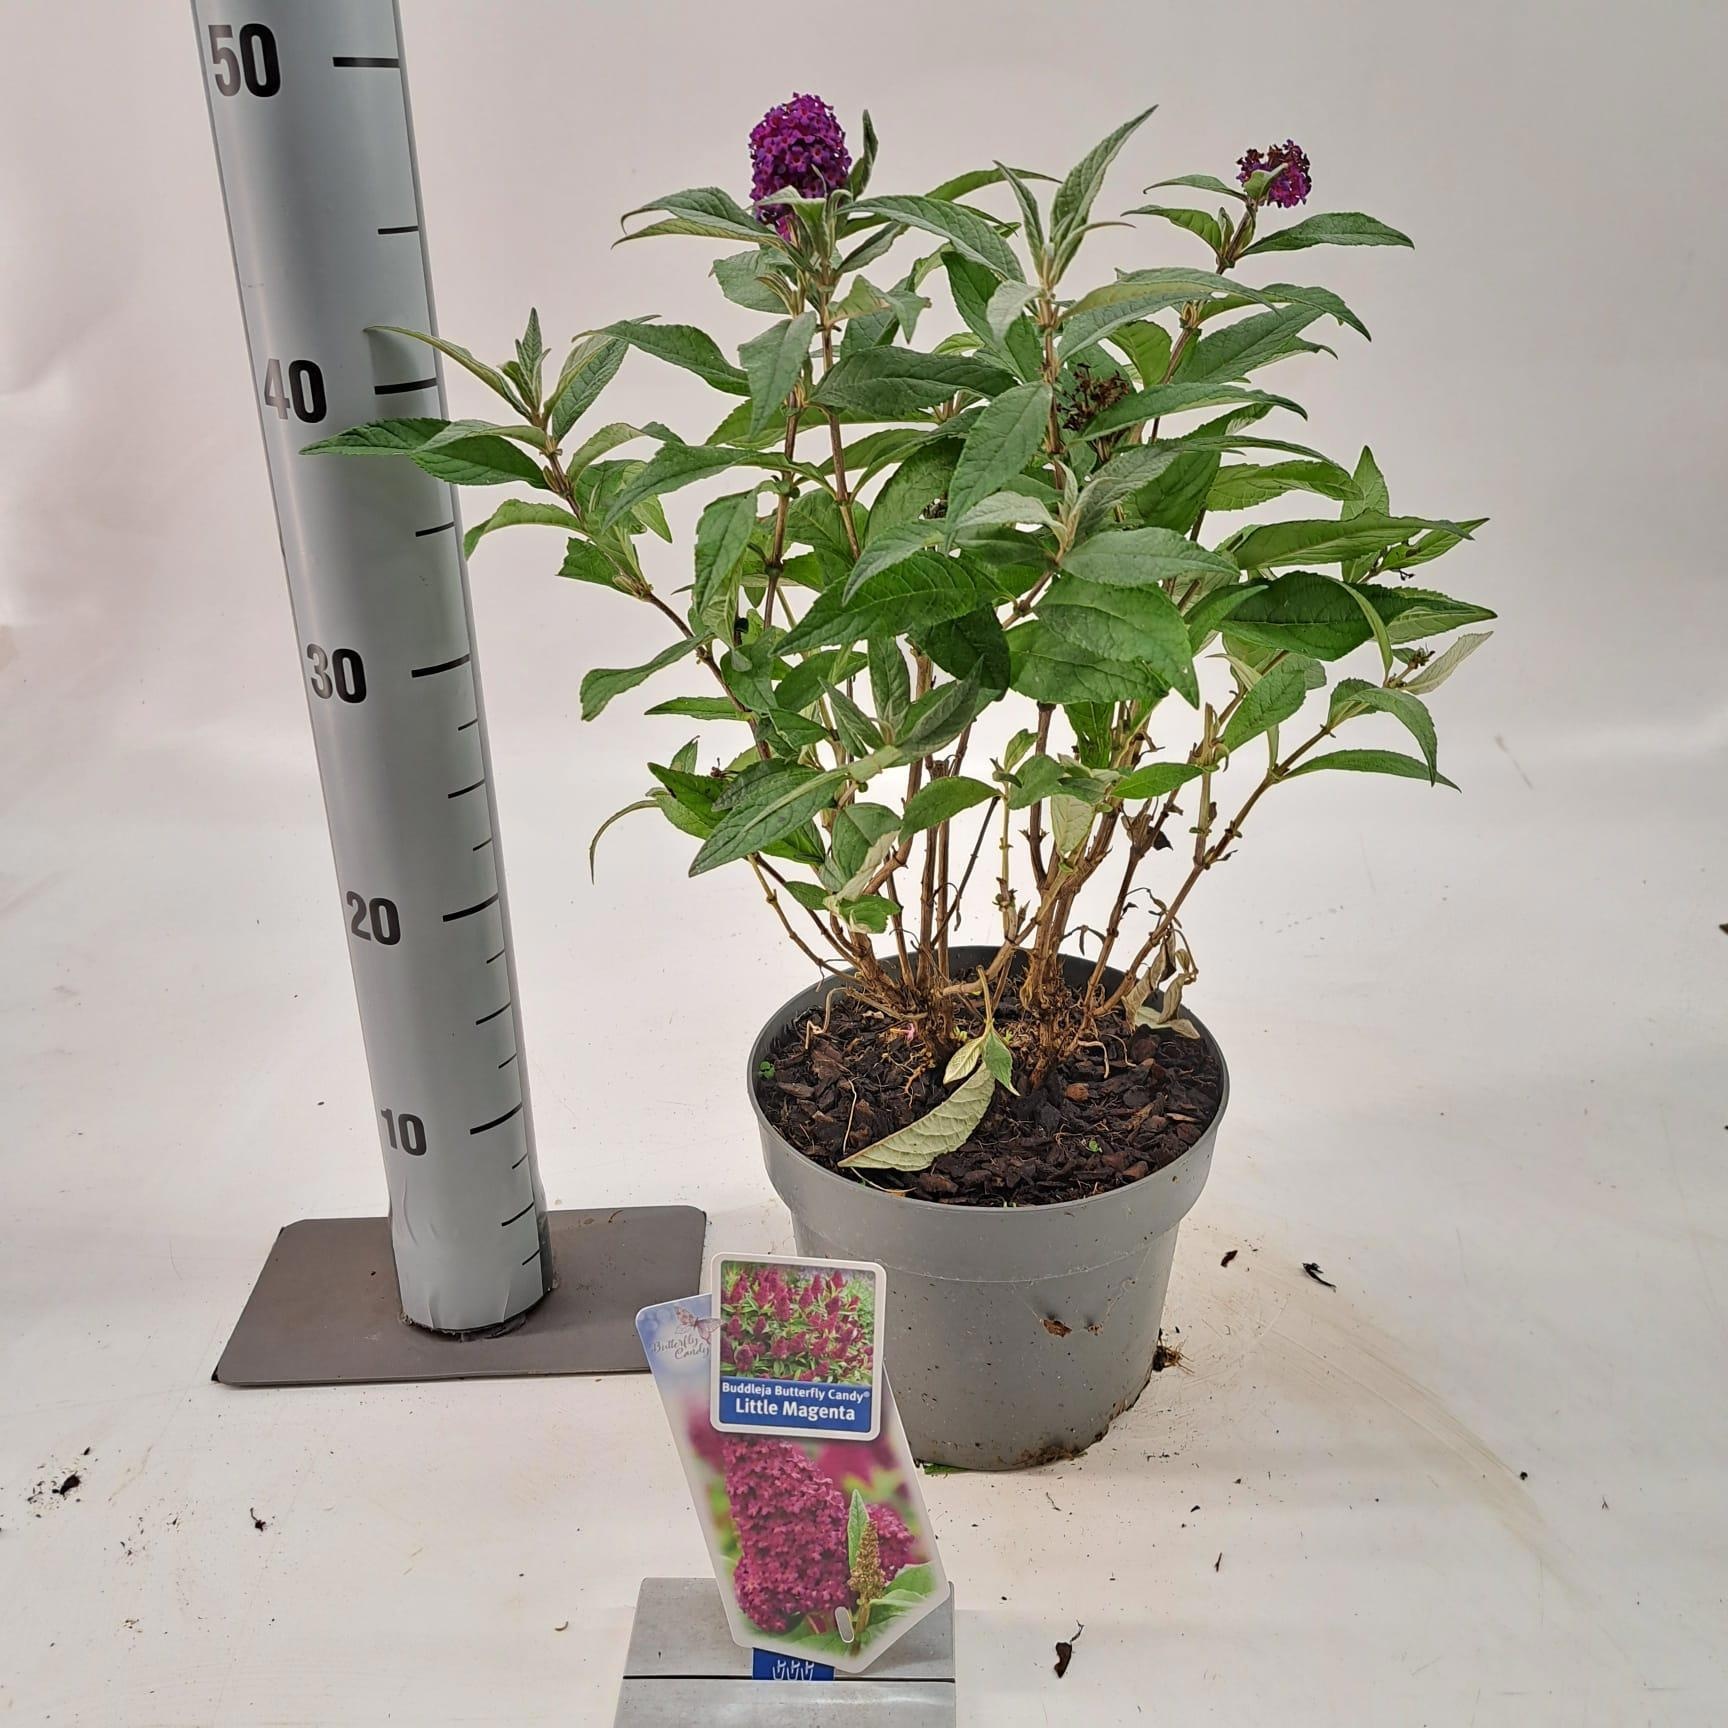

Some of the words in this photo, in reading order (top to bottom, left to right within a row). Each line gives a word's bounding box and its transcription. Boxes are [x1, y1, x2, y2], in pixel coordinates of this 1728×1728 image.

[207, 23, 281, 97] 50
[263, 358, 326, 423] 40
[306, 644, 366, 704] 30
[346, 890, 400, 945] 20
[381, 1108, 426, 1156] 10
[652, 1335, 698, 1353] Butterfly
[675, 1342, 710, 1360] Candy
[722, 1382, 771, 1397] Buddleja
[775, 1385, 826, 1401] Butterfly
[736, 1398, 778, 1415] Little
[783, 1401, 855, 1421] Magenta
